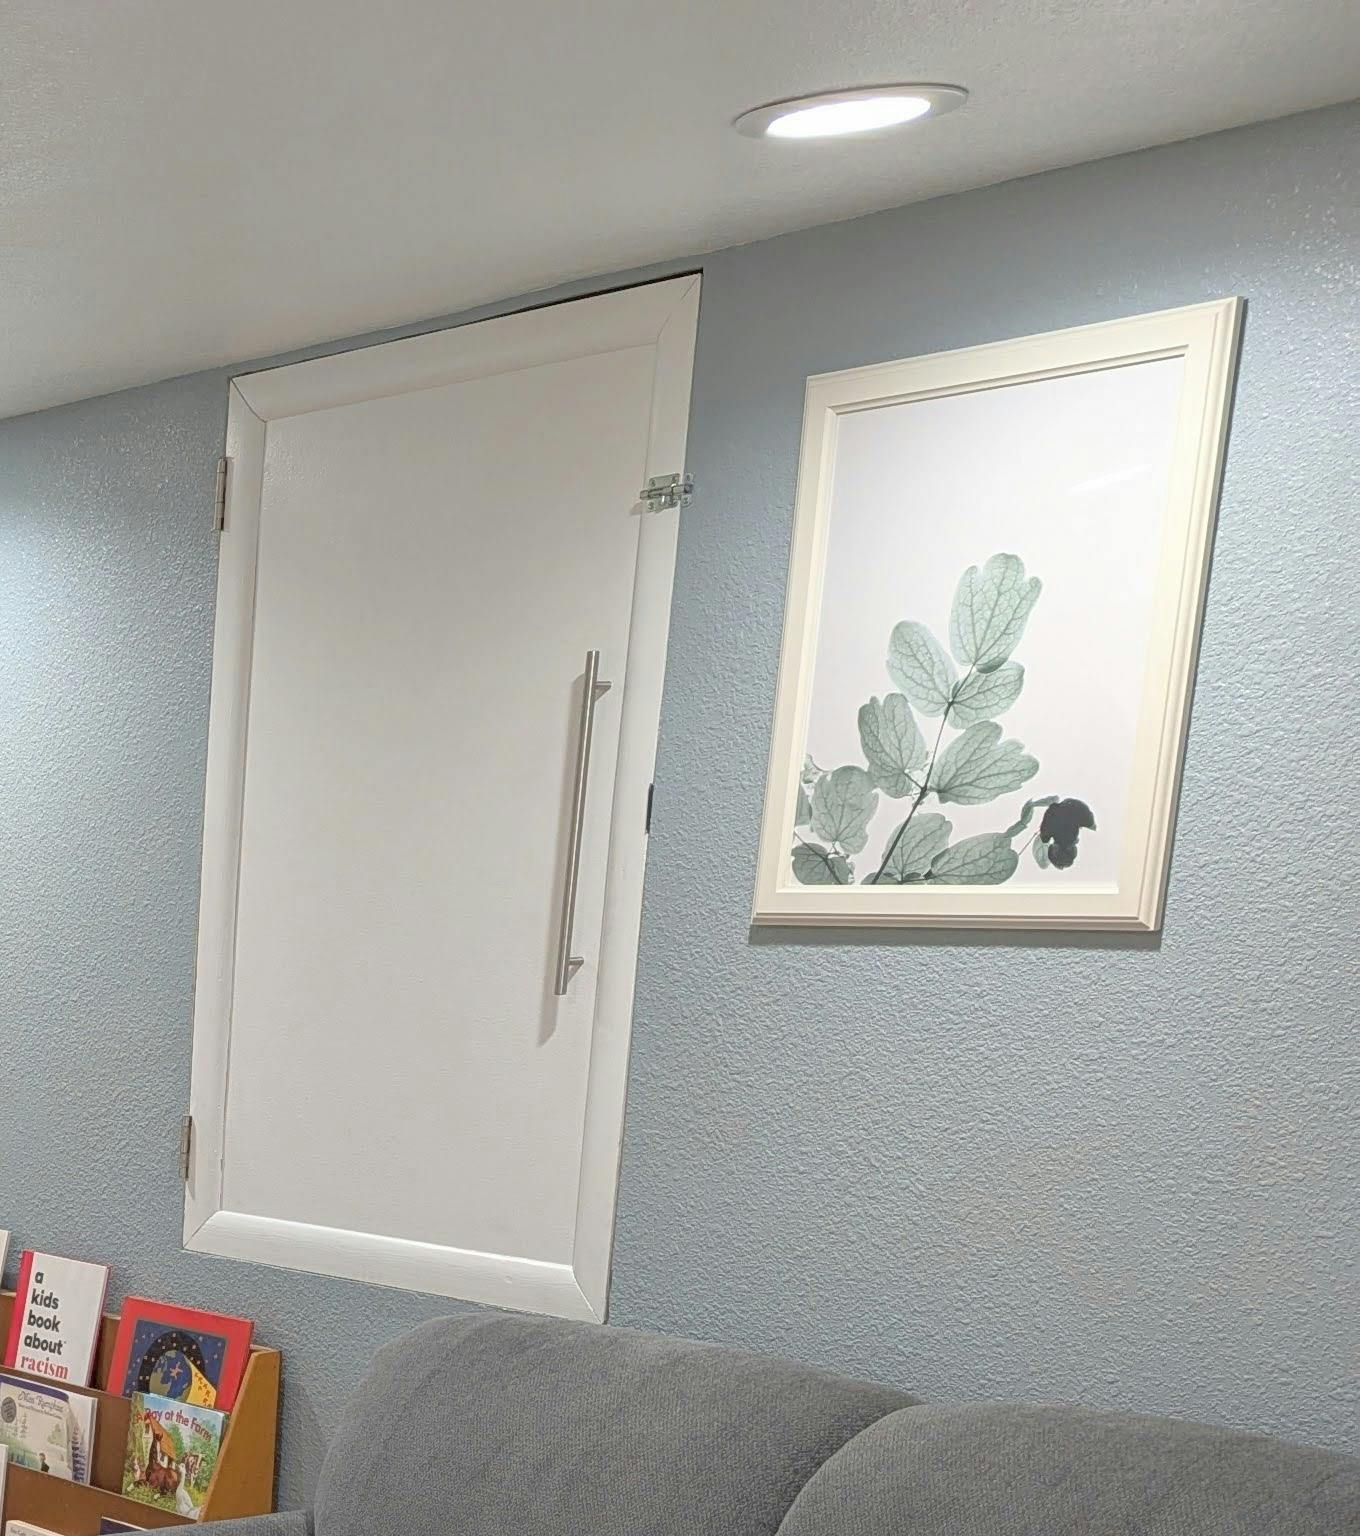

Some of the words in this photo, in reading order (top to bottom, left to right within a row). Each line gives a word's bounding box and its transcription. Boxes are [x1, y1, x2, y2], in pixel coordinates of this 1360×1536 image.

[34, 1271, 44, 1284] a
[31, 1288, 60, 1310] kids
[27, 1310, 61, 1333] book
[23, 1332, 64, 1355] about
[20, 1355, 69, 1380] racism
[164, 1409, 175, 1421] at
[175, 1409, 190, 1427] the
[190, 1416, 212, 1442] Farm
